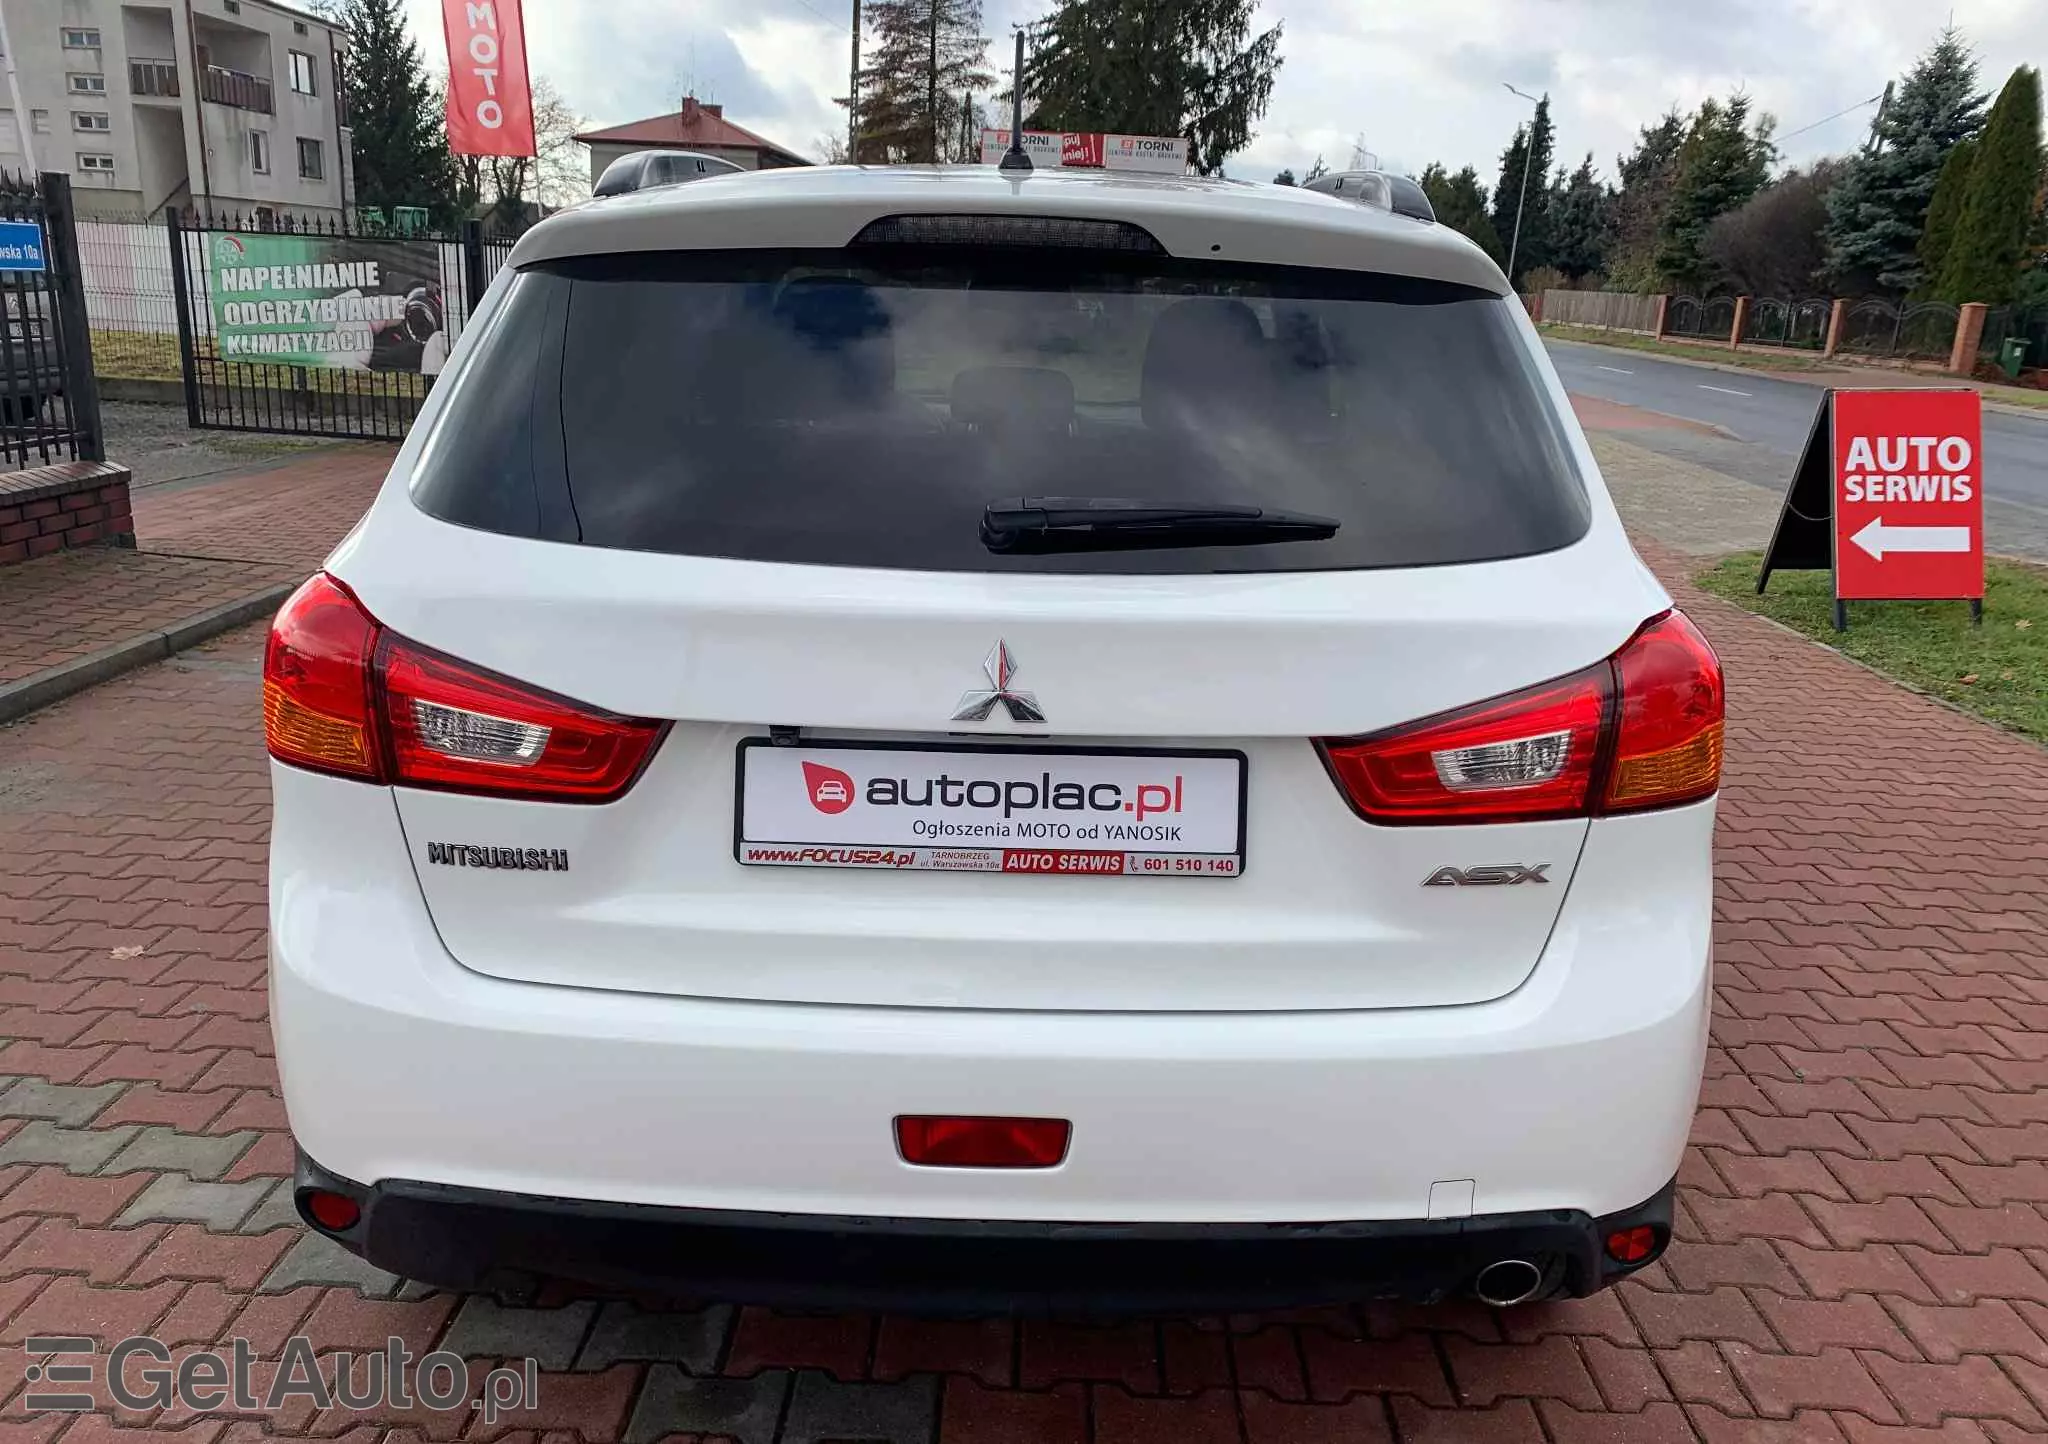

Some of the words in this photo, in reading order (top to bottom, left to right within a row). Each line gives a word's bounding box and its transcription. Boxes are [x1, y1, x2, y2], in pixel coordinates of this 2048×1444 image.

[465, 2, 503, 129] MOTO
[1136, 140, 1174, 152] TORNI
[221, 262, 380, 291] NAPEŁNIANIE
[224, 296, 406, 326] ODGRZYBIANIE
[227, 330, 372, 354] KLIMATYZACJI
[1845, 436, 1972, 472] AUTO
[1845, 475, 1972, 502] SERWIS
[866, 773, 1183, 821] autoplac.pl
[912, 819, 1011, 839] Ogłoszenia
[1017, 823, 1071, 839] MOTO
[1076, 824, 1099, 840] od
[1104, 825, 1182, 841] YANOSIK
[427, 841, 569, 871] MITSUBISHI
[747, 848, 916, 867] www.FOCUS24.pl
[931, 851, 990, 860] TARNOBRZEG
[1006, 854, 1053, 870] AUTO
[1058, 856, 1120, 872] SERWIS
[1144, 858, 1170, 870] 601
[1176, 859, 1202, 871] 510
[1208, 860, 1234, 872] 140
[1421, 862, 1553, 887] ASX
